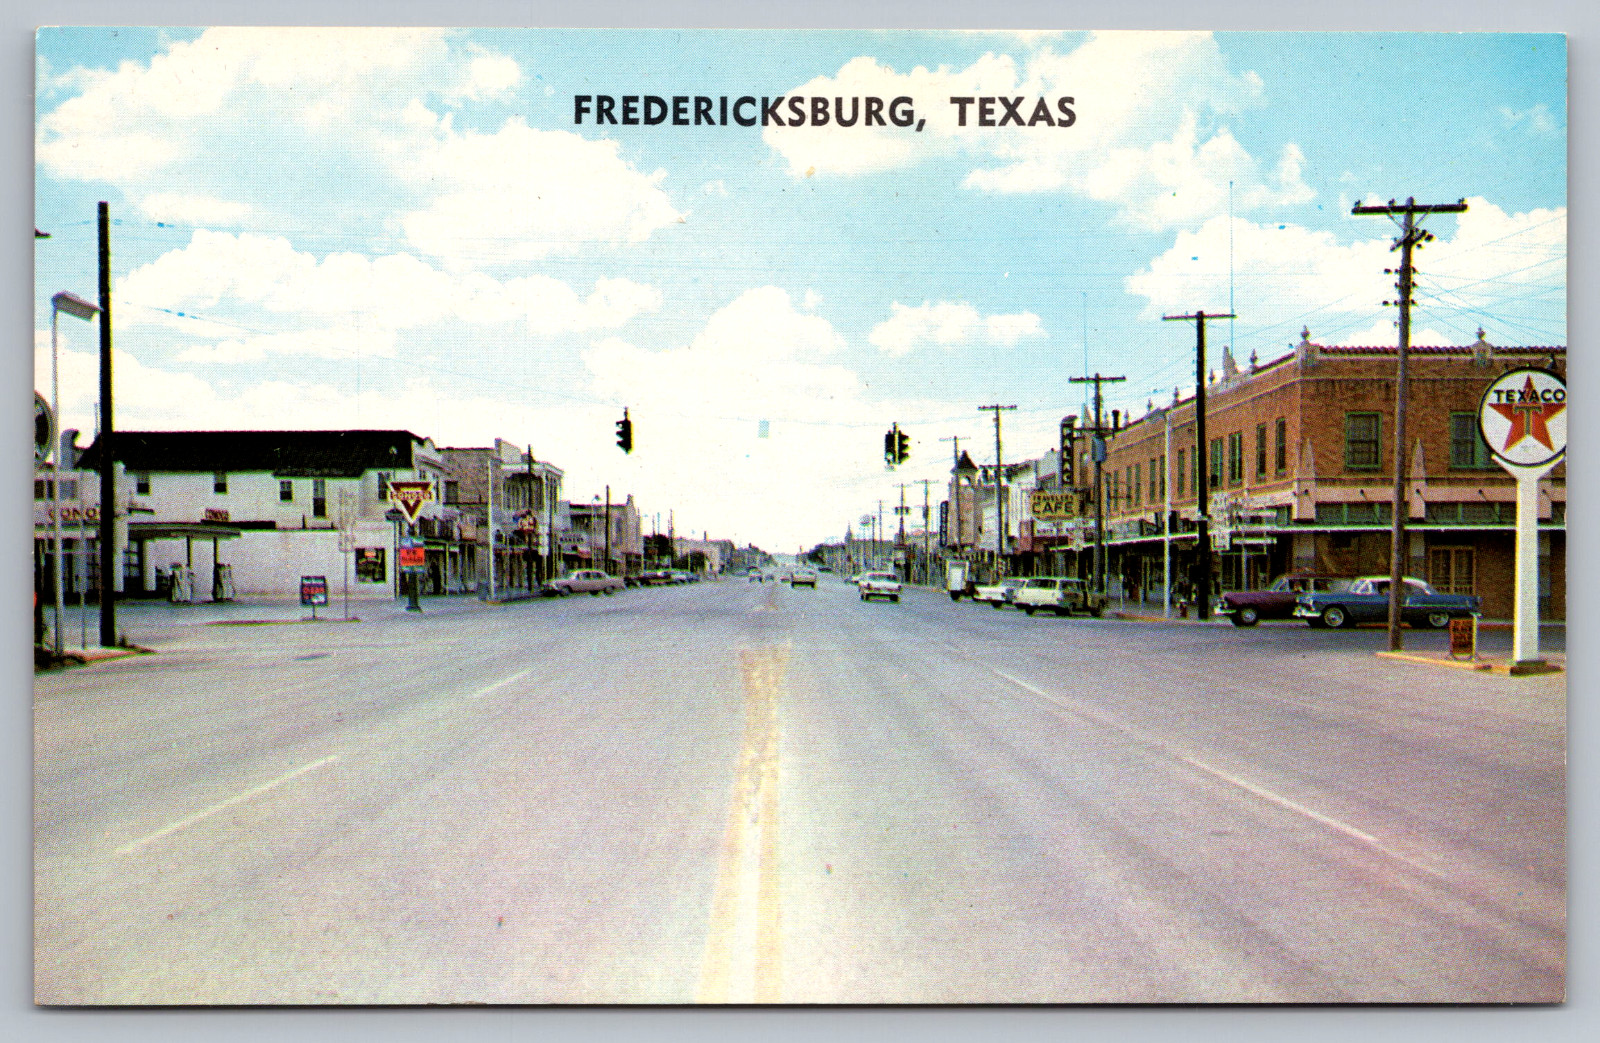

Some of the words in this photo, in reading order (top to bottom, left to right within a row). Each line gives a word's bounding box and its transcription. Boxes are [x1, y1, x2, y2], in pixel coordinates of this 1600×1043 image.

[1493, 388, 1566, 403] TEXACO
[1062, 427, 1073, 484] PALAC
[1032, 502, 1074, 515] CAFE
